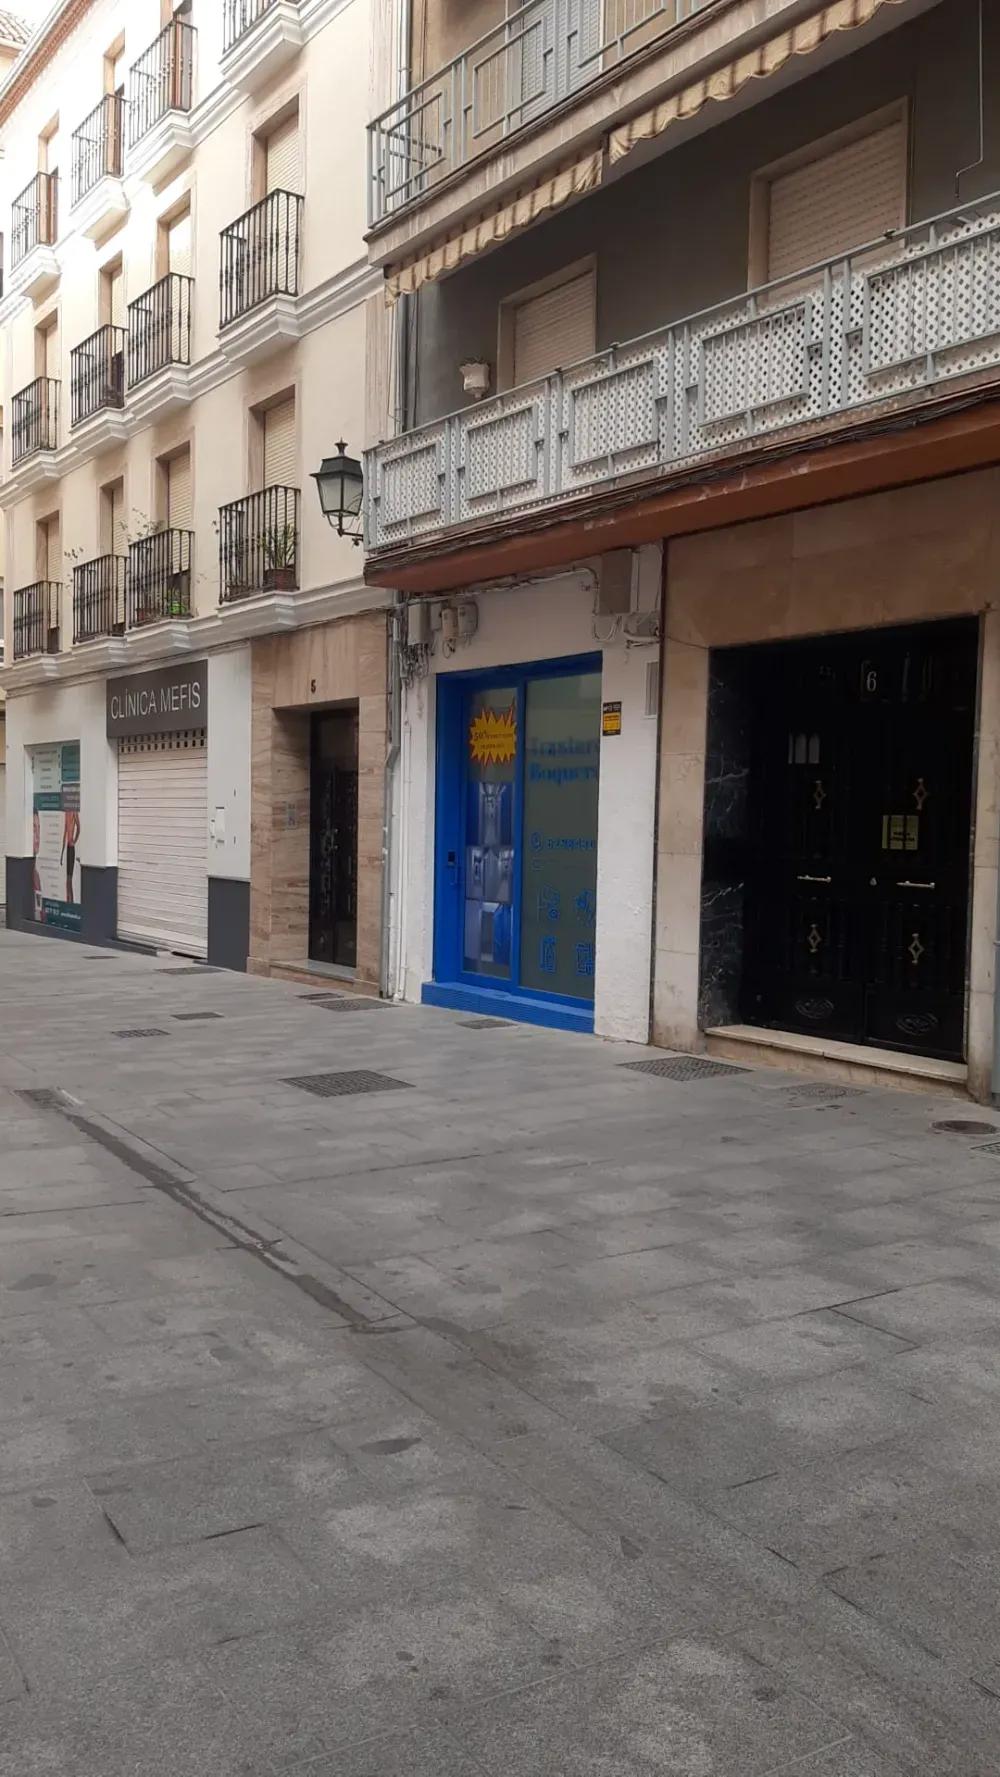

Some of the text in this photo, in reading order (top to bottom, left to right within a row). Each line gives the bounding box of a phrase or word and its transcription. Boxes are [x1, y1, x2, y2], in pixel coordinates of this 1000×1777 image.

[310, 678, 317, 694] 5
[866, 670, 877, 692] 6
[110, 682, 201, 719] CLÍNICA MEFIS
